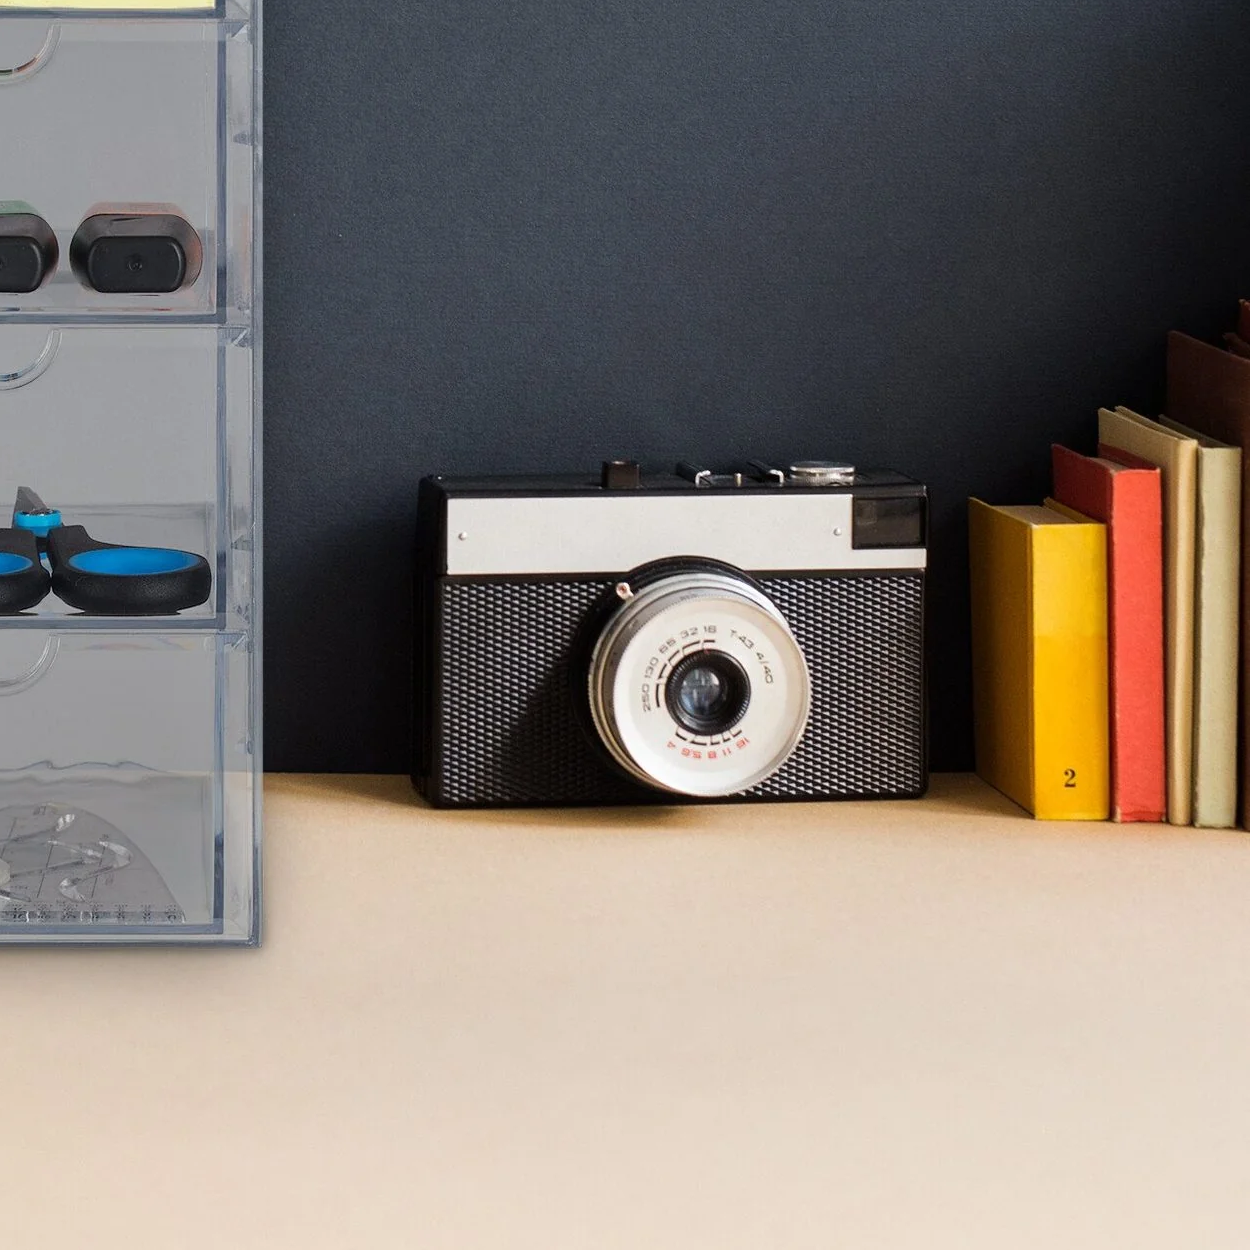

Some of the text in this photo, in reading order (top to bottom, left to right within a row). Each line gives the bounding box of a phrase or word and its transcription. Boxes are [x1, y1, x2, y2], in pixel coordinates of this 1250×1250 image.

[680, 627, 698, 639] 32
[703, 625, 717, 634] 16
[644, 656, 659, 679] 130
[756, 651, 774, 684] 4/40
[641, 683, 651, 712] 250
[666, 741, 676, 750] 4
[707, 750, 717, 759] 8
[722, 747, 732, 757] 11
[1064, 768, 1076, 788] 2
